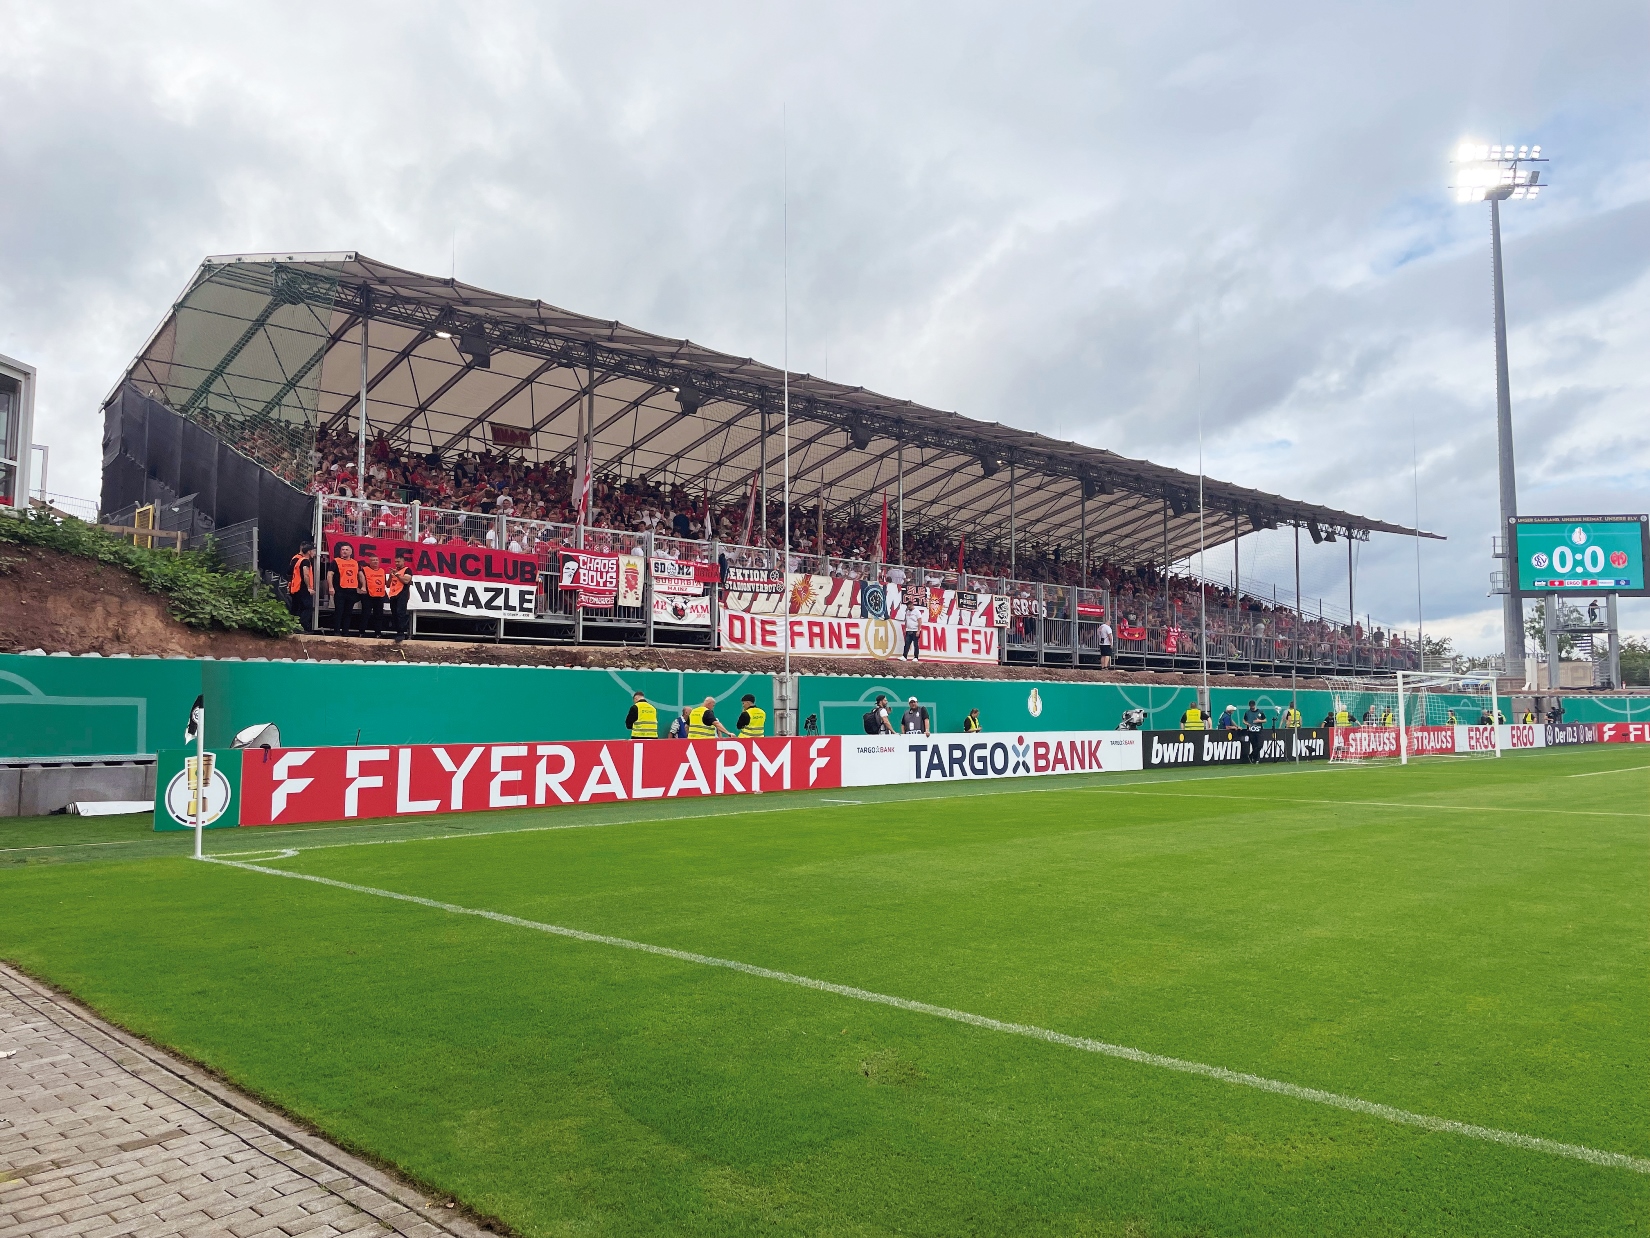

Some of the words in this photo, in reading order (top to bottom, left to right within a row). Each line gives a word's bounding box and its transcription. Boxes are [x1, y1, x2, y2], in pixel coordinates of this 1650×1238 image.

[579, 555, 616, 572] CHAOS
[1552, 546, 1605, 573] 0:0
[579, 569, 616, 587] BOYS
[414, 581, 534, 612] WEAZLE
[728, 614, 778, 648] DIE
[789, 620, 860, 650] FANS
[957, 628, 994, 656] FSV
[1202, 732, 1242, 762] bwin
[1349, 731, 1397, 753] STRAUSS
[1413, 730, 1452, 751] STRAUSS
[1468, 726, 1496, 751] ERGO
[1510, 725, 1535, 748] ERGO
[1554, 725, 1567, 744] Der
[1566, 725, 1578, 743] ID.3
[1151, 733, 1195, 765] bwin
[344, 739, 791, 817] FLYERALARM
